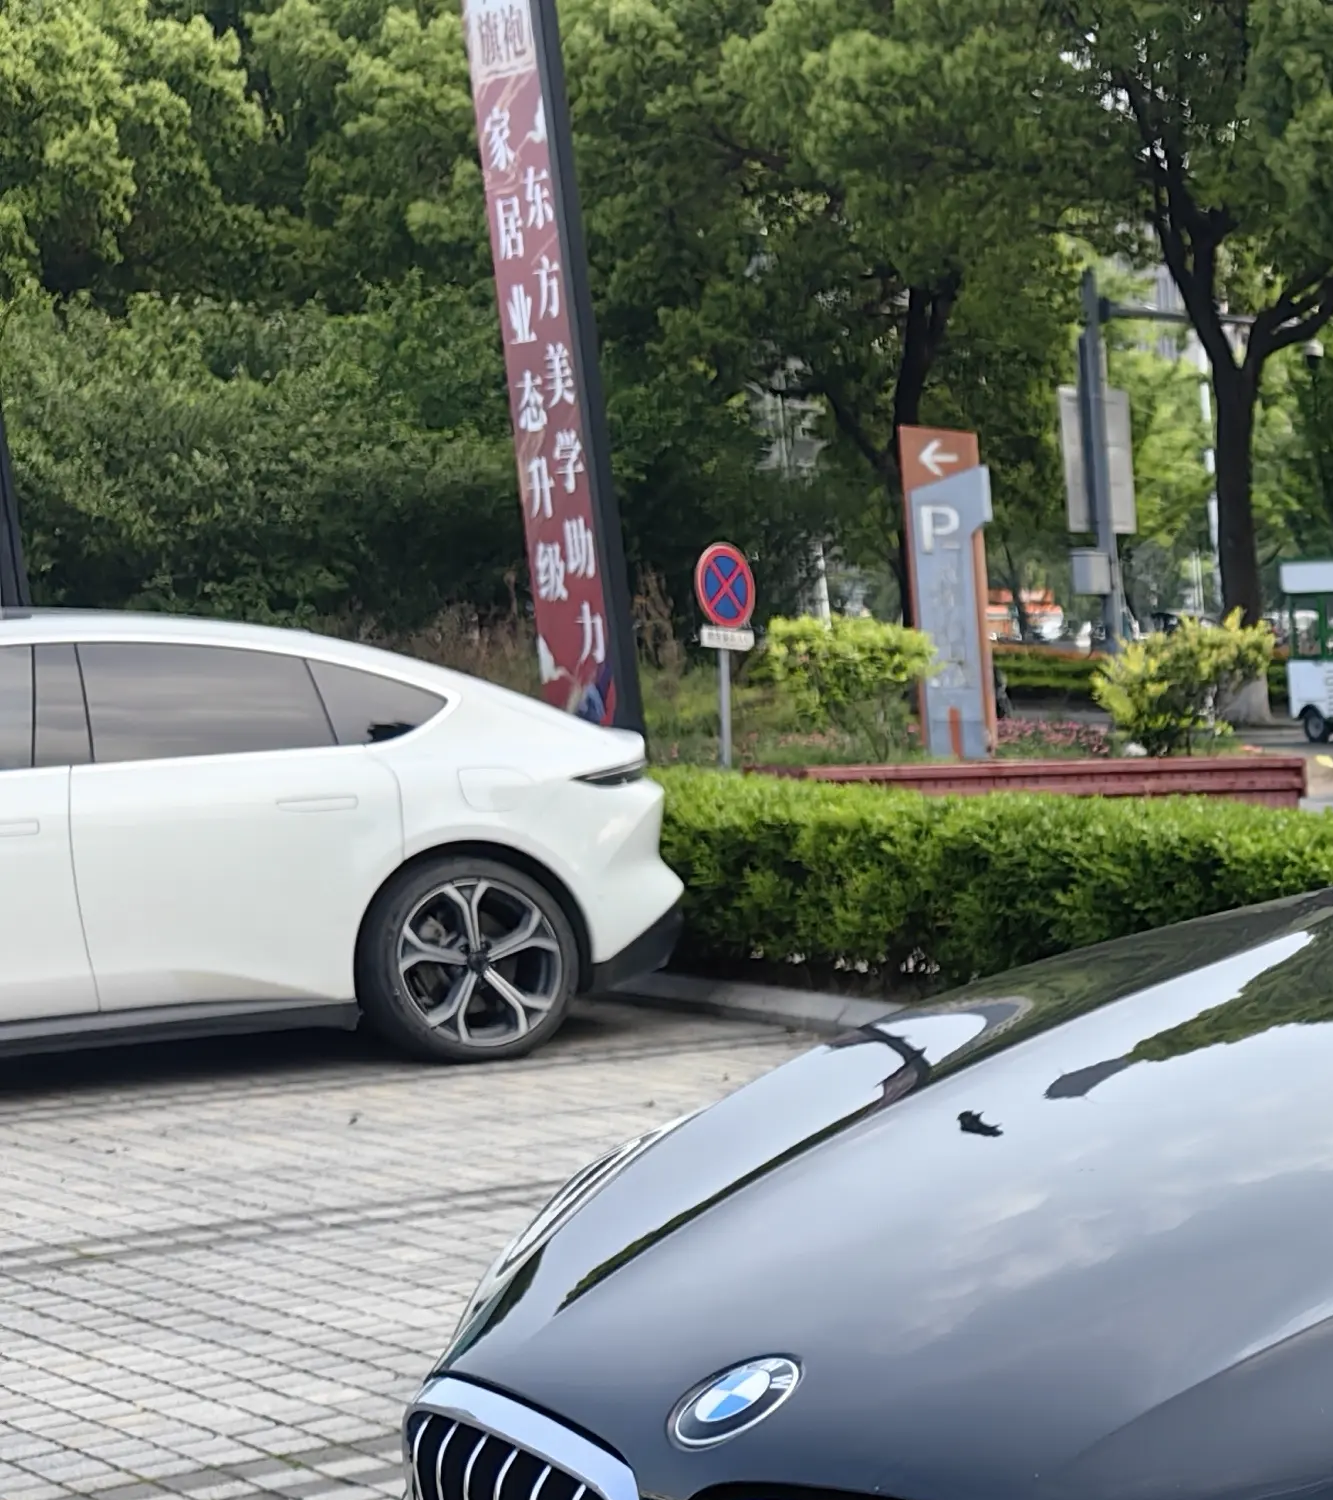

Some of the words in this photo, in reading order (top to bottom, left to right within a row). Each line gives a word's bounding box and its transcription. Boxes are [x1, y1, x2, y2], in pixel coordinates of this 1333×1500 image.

[484, 106, 569, 603] 家居业态升级
[523, 165, 606, 664] 东方美学助力
[920, 504, 960, 554] P
